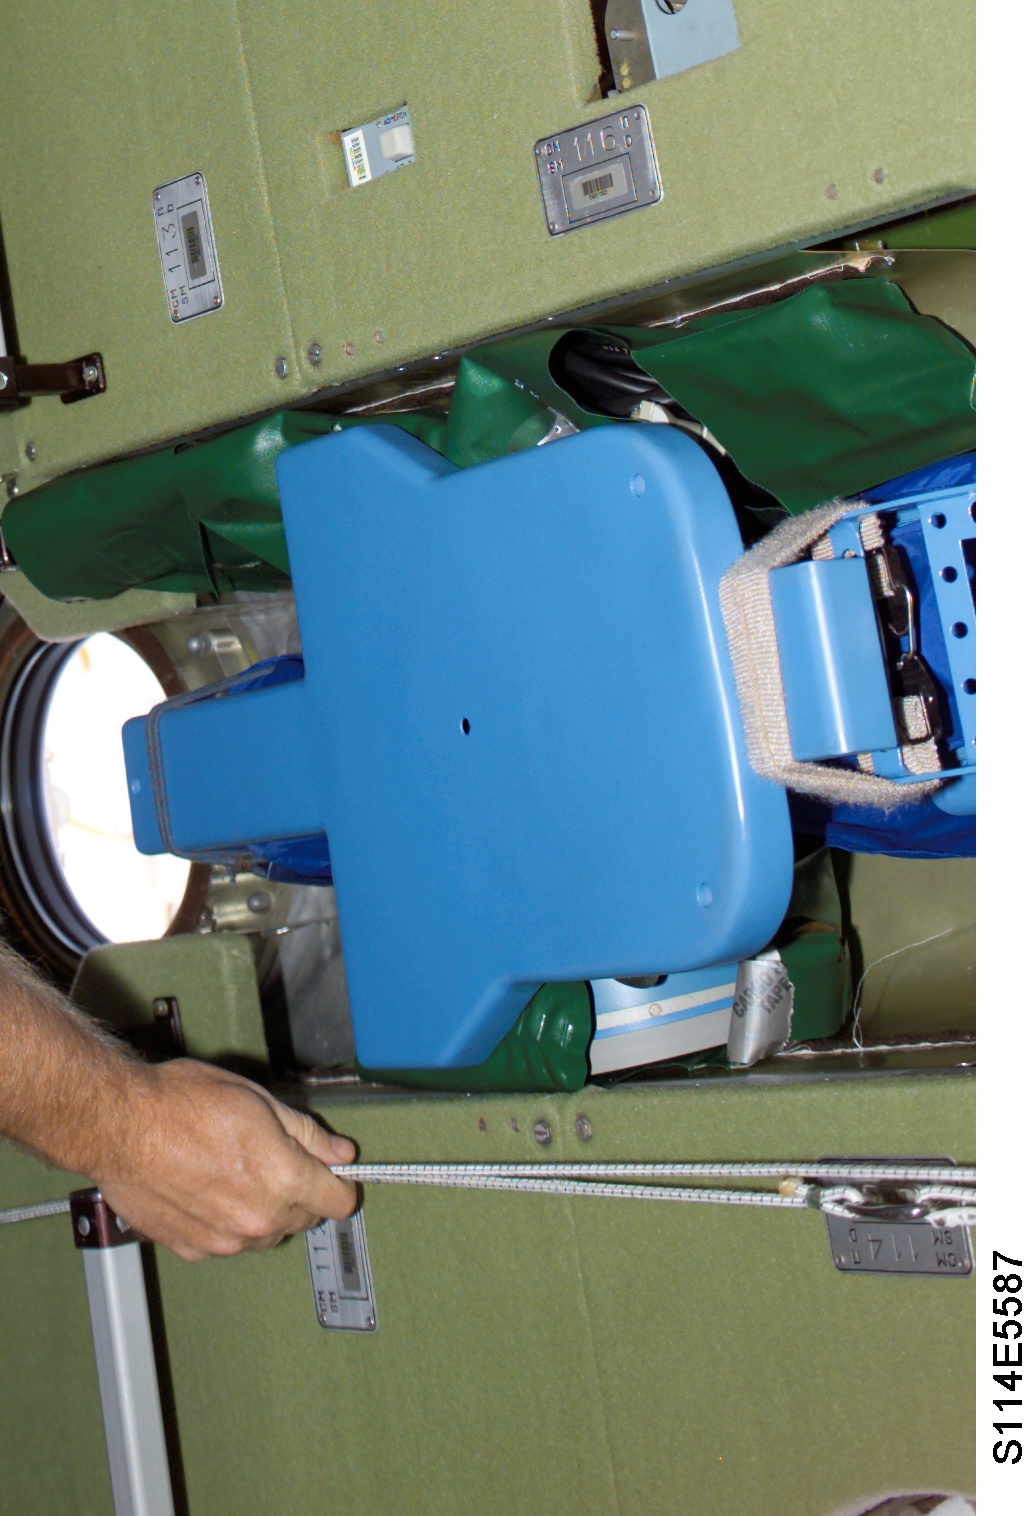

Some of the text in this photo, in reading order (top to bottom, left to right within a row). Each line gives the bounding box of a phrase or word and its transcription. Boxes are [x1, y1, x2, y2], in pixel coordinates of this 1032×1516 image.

[573, 125, 616, 161] 116
[162, 223, 181, 273] 113
[179, 285, 189, 305] SM
[760, 976, 790, 1014] TAPE
[868, 1233, 920, 1262] 114
[932, 1230, 953, 1245] SM
[328, 1291, 339, 1313] SM
